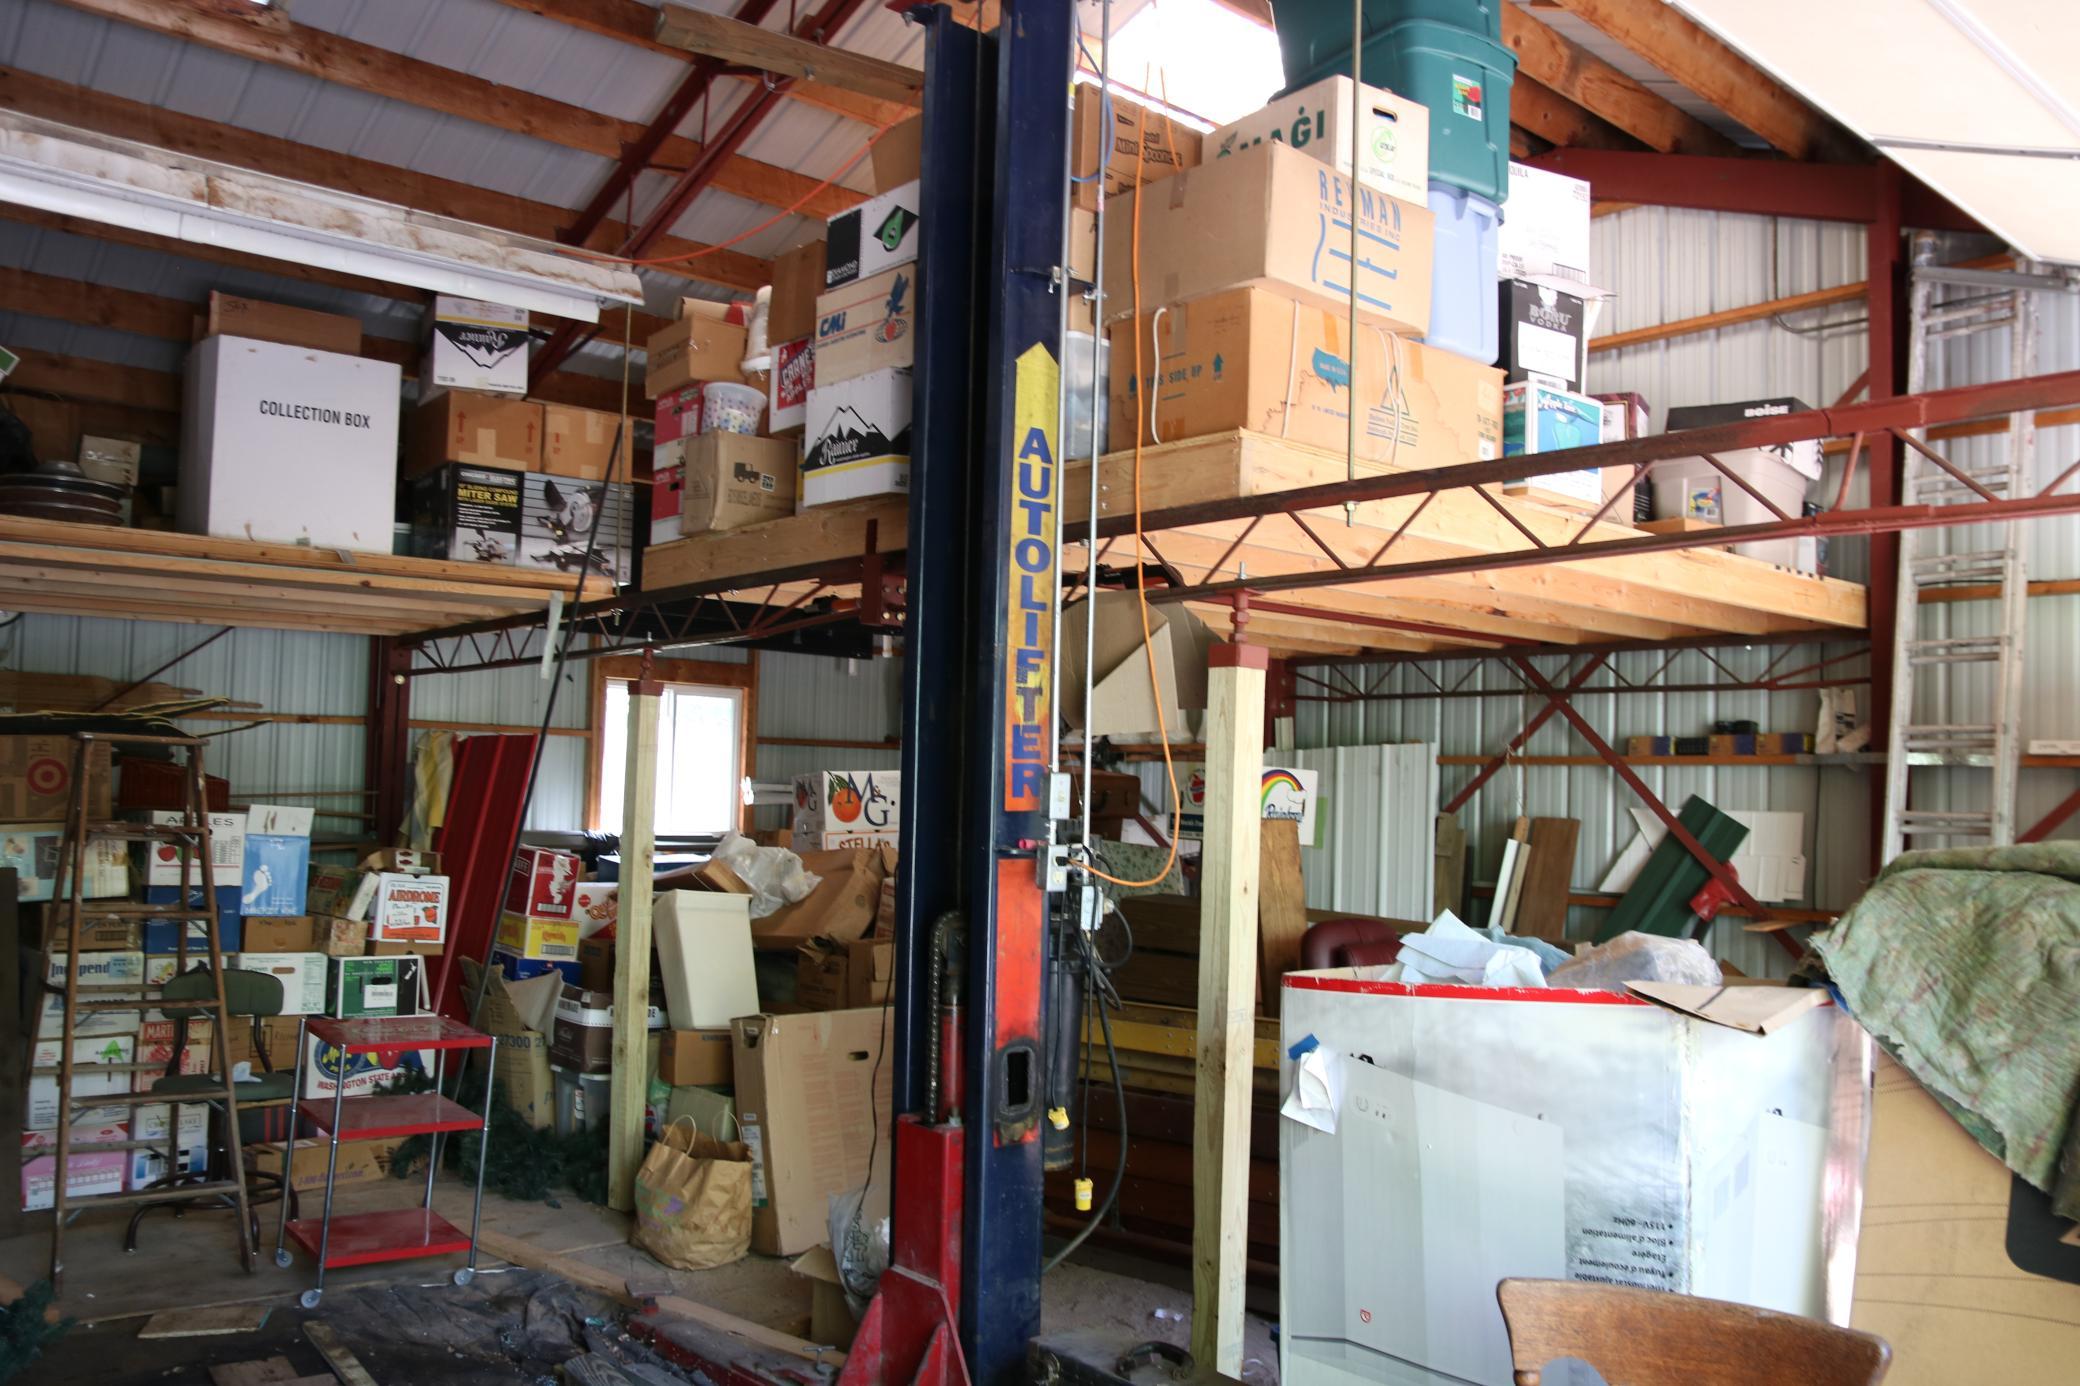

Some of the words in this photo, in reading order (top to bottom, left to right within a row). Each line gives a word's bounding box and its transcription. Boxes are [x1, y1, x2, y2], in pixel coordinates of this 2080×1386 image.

[1320, 203, 1383, 233] INDUSRIES
[259, 399, 341, 425] COLLECTION
[344, 412, 371, 429] BOX
[457, 488, 492, 500] MITER
[494, 493, 519, 504] SAW
[1010, 426, 1053, 799] AUTOLIFTER
[388, 889, 441, 904] AIRDROME
[369, 1072, 390, 1085] STATE
